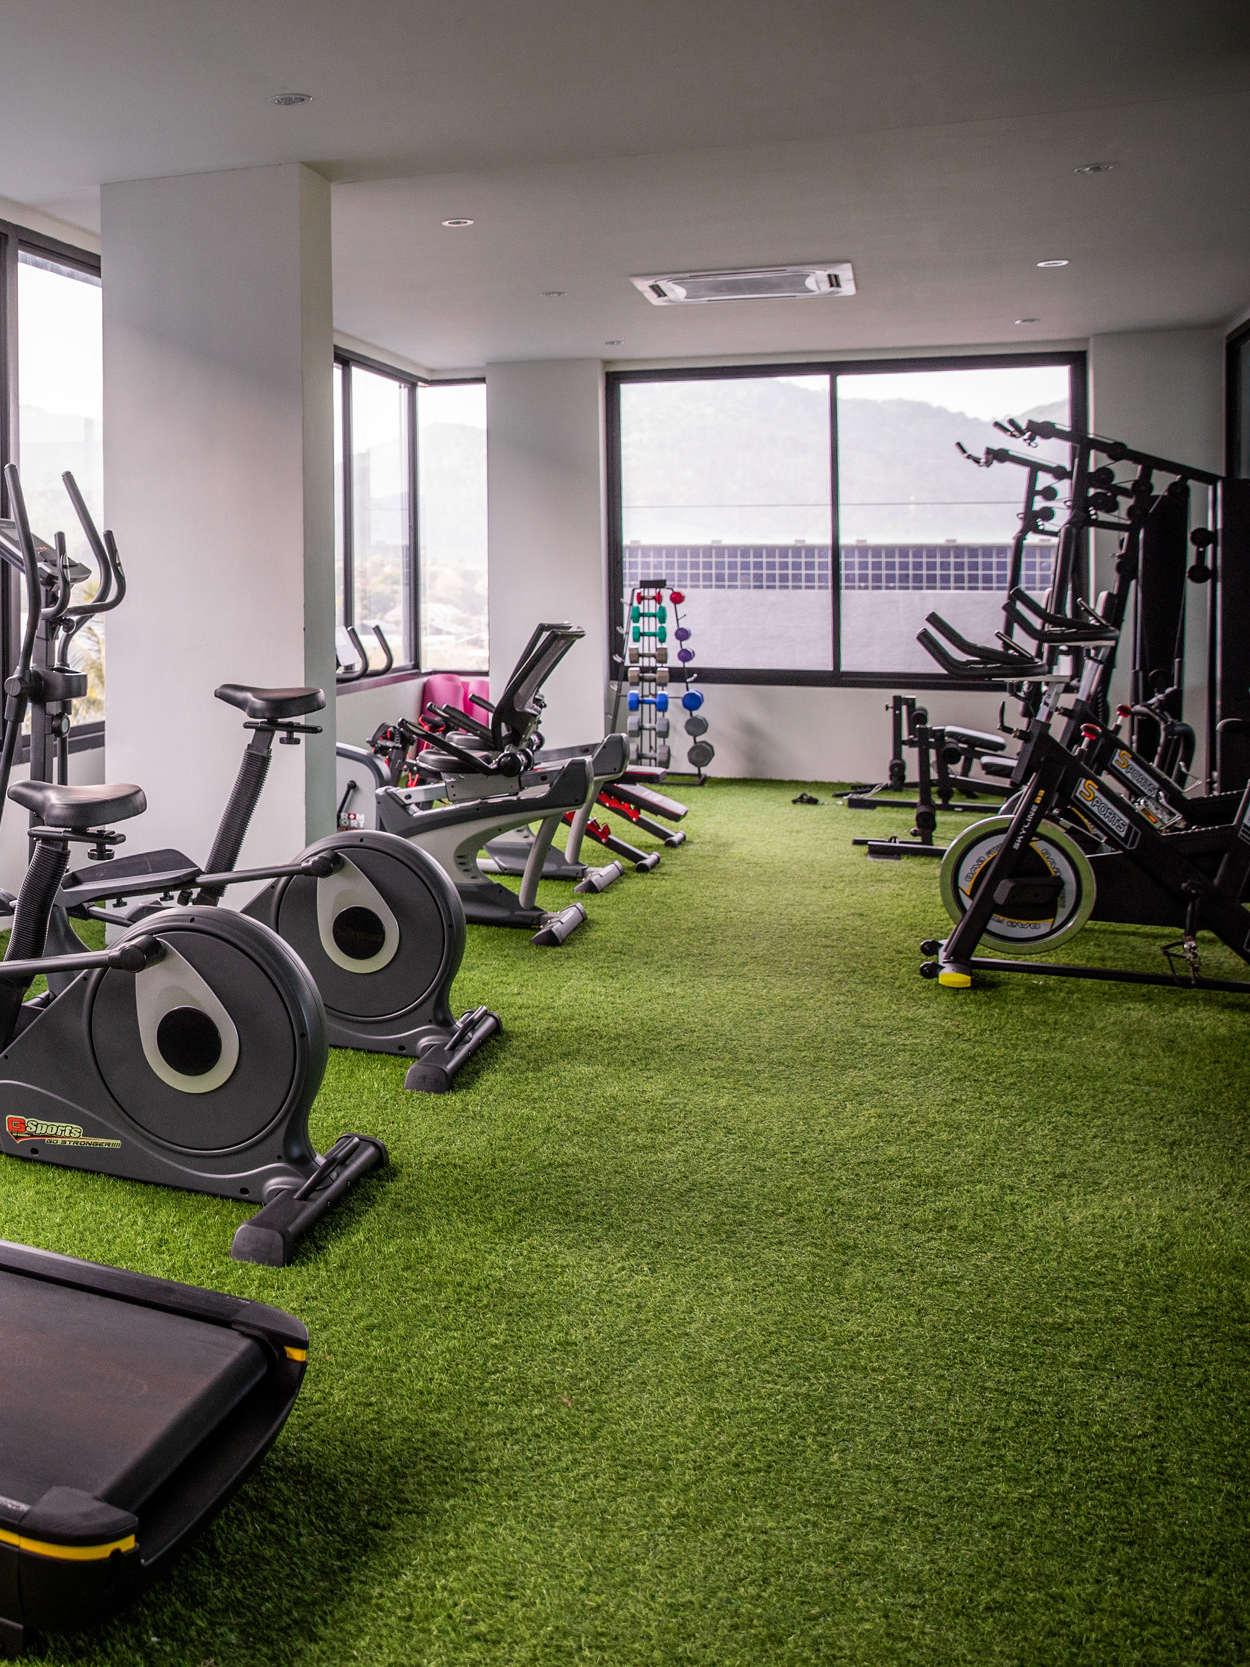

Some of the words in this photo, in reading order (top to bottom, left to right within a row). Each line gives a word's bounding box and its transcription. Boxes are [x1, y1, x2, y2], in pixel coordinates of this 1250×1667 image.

[1114, 749, 1157, 797] SPORTS
[1012, 804, 1039, 850] SKYLINE
[1079, 780, 1127, 833] SPORTS
[61, 1140, 111, 1148] STRONGER
